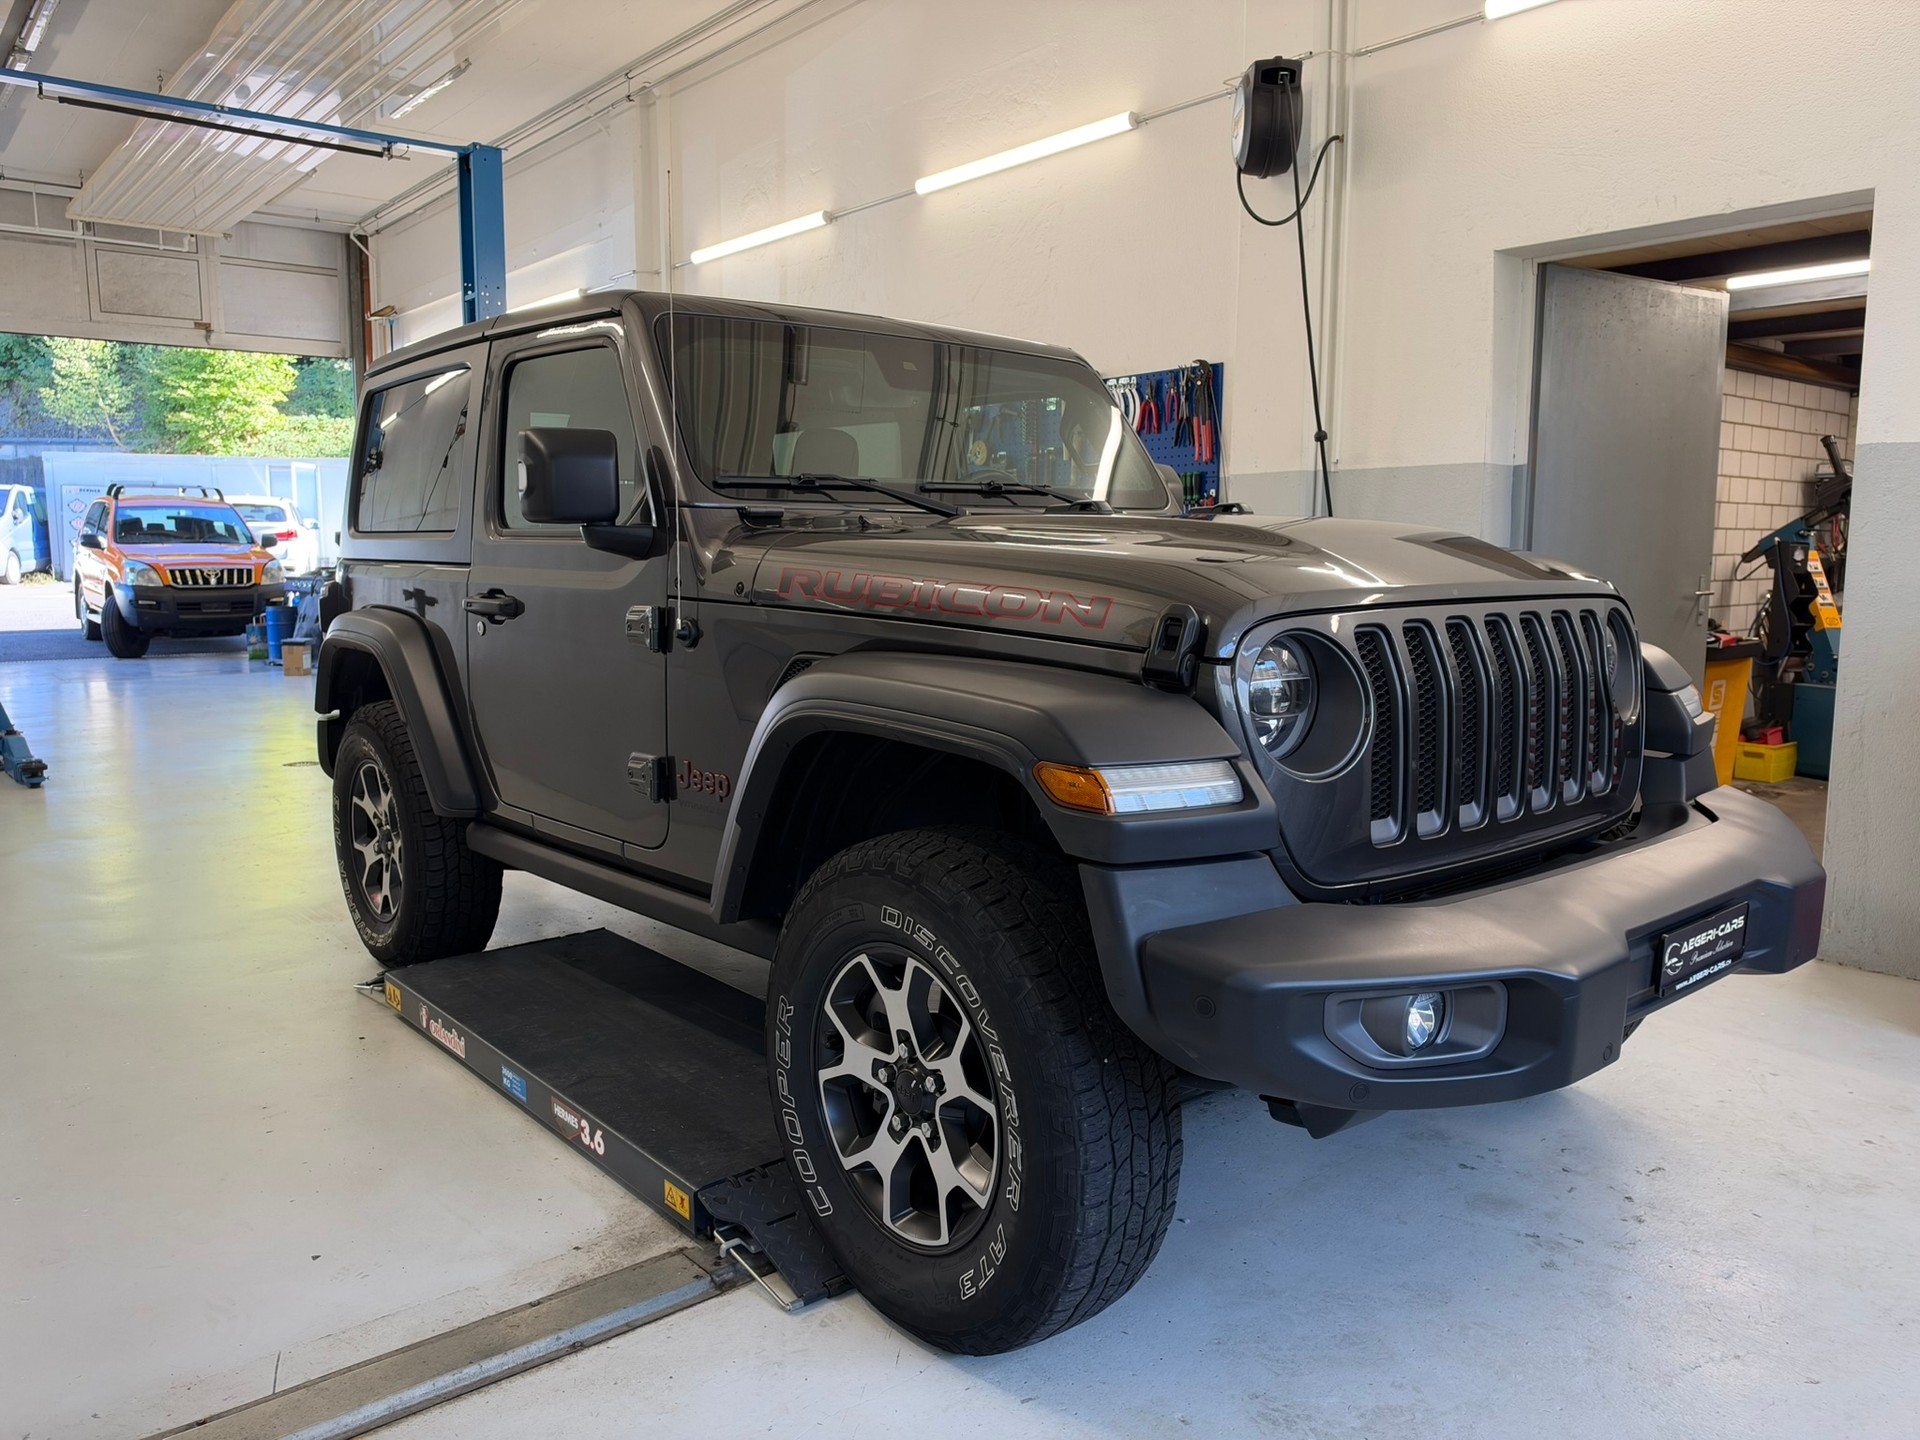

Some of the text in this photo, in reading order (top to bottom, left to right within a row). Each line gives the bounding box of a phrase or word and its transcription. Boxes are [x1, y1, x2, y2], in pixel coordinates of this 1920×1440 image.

[776, 567, 1116, 629] RUBICON
[677, 760, 731, 802] Jeep
[1680, 915, 1745, 955] AEGERI-CARS
[553, 1103, 579, 1130] HERMES
[774, 994, 833, 1217] COOPER
[880, 905, 1022, 1300] DISCOVERER AT3
[580, 1118, 605, 1156] 3.6
